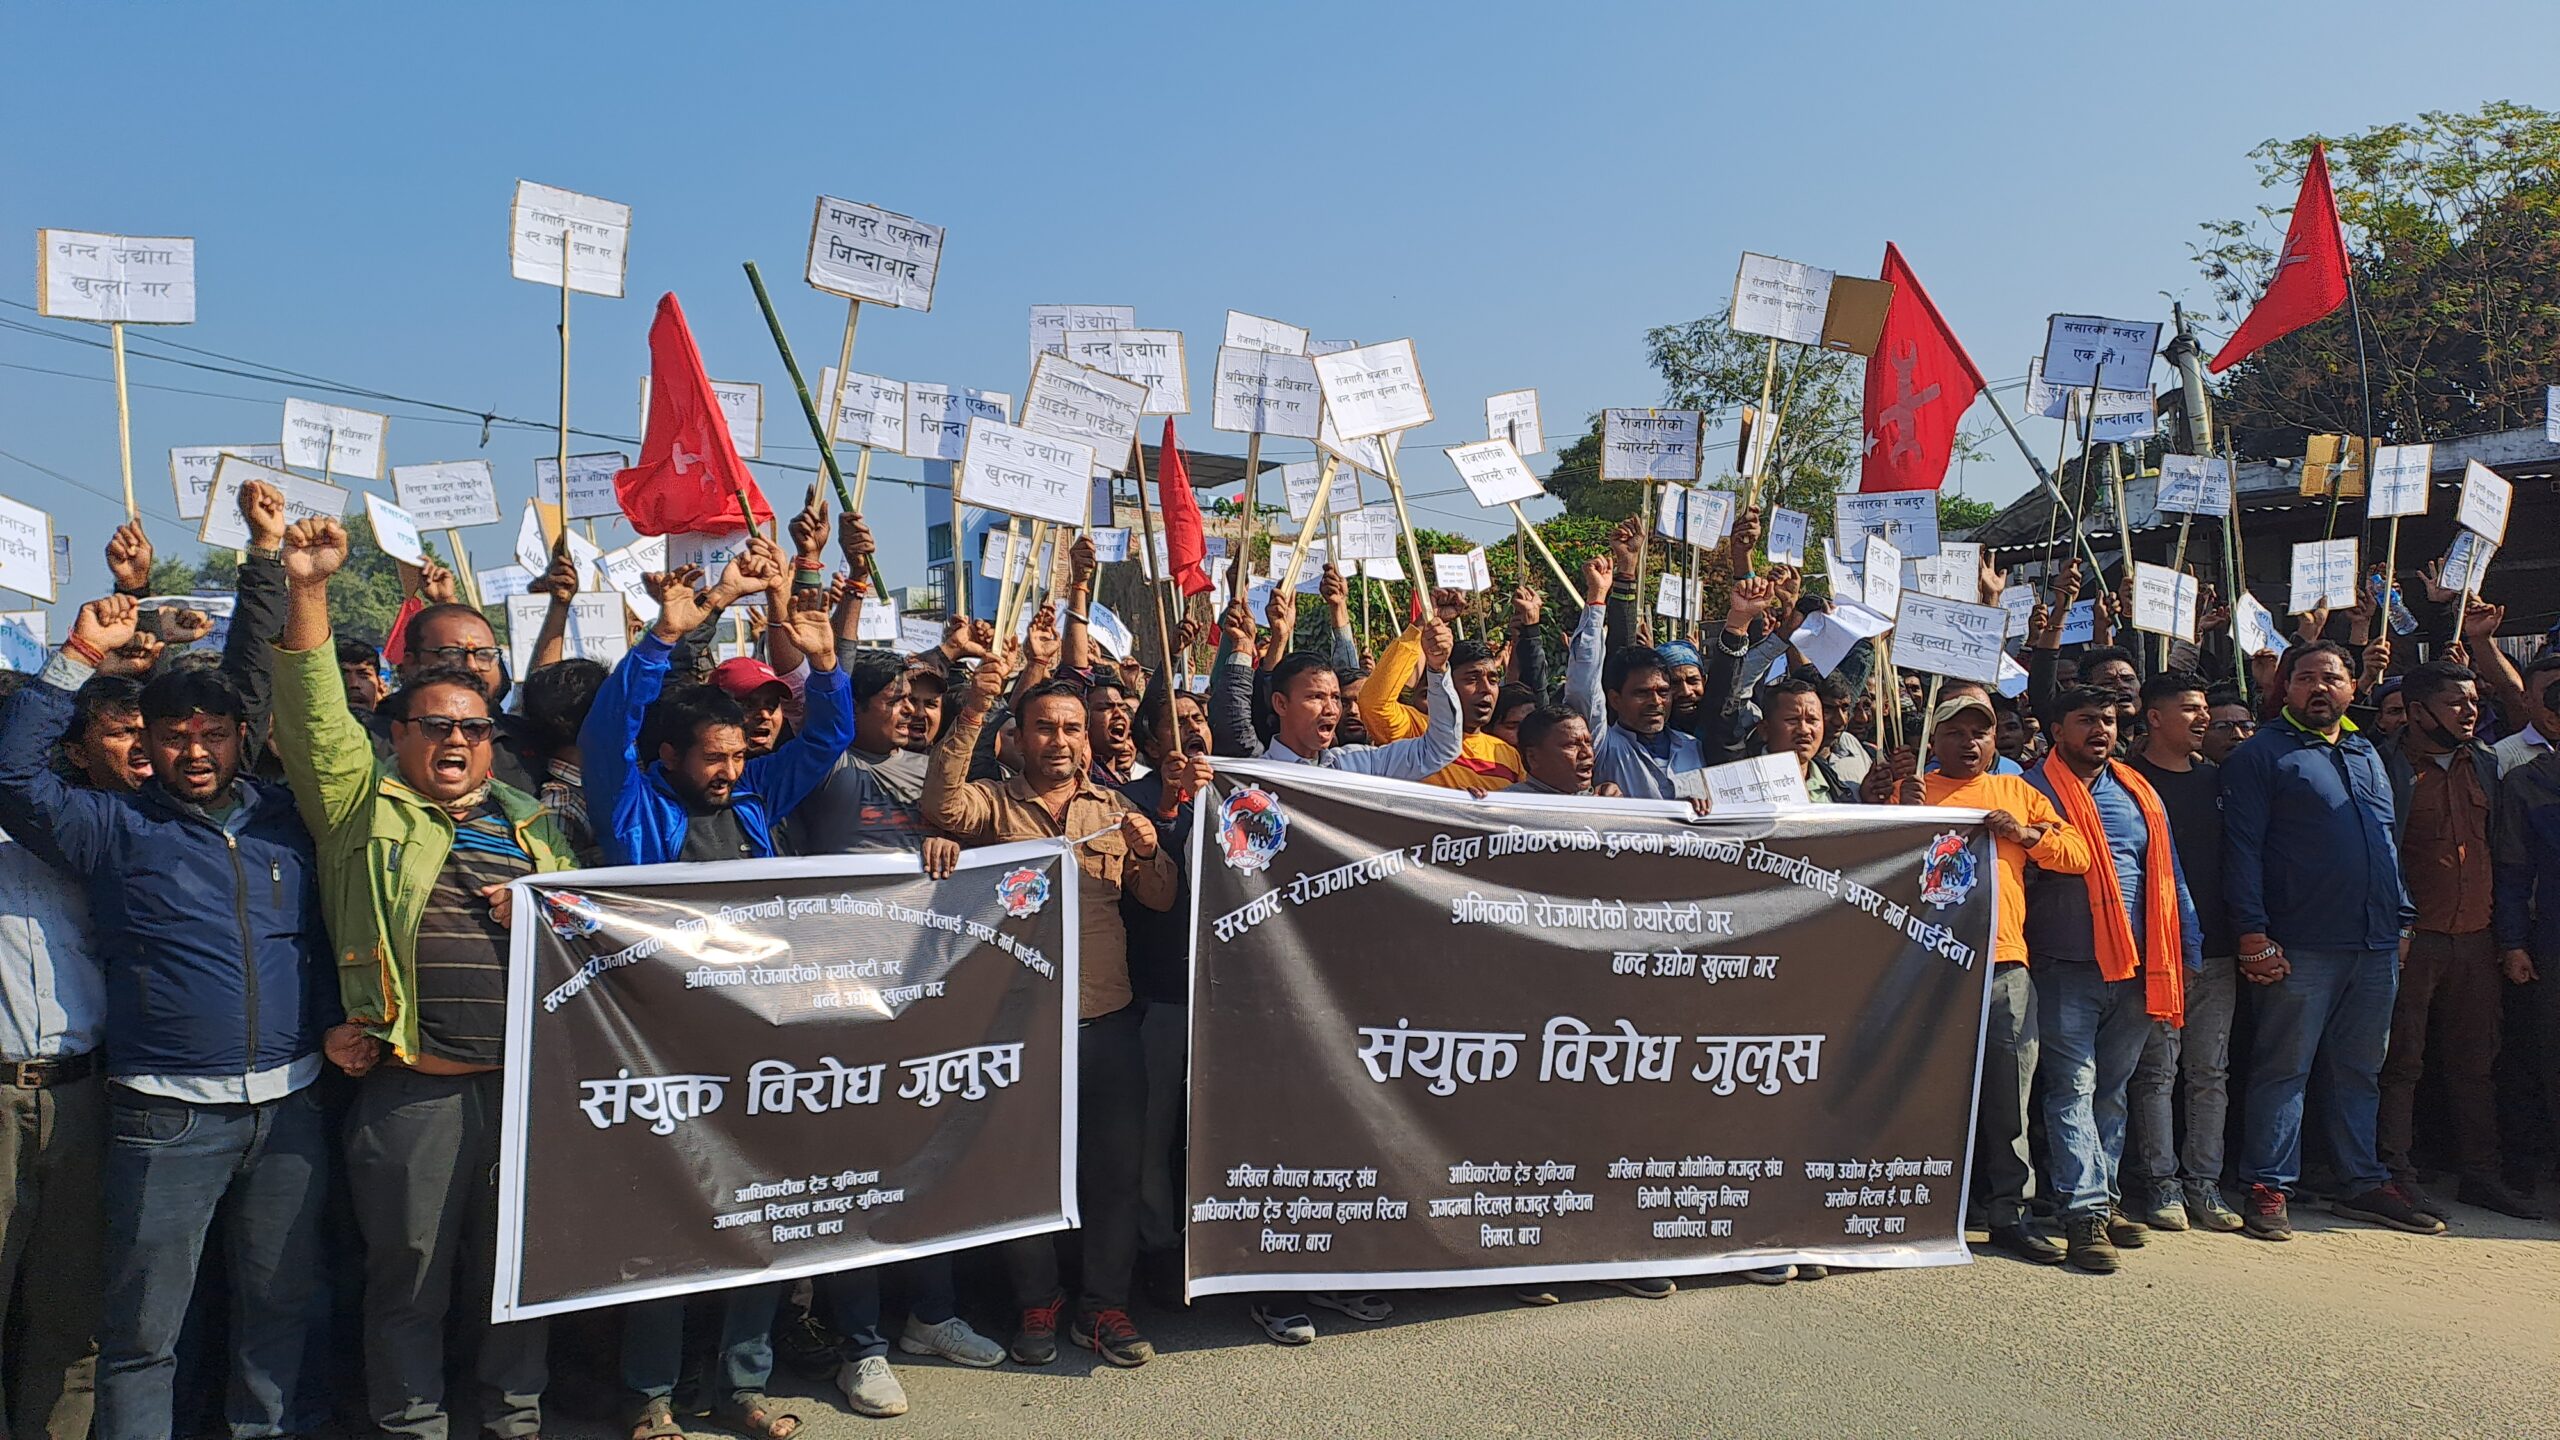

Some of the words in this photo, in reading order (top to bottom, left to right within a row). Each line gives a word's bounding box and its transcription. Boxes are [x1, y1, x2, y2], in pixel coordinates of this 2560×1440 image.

[597, 227, 610, 239] गर
[830, 208, 879, 237] मजदुर
[887, 224, 931, 248] एकता
[58, 243, 99, 260] बन्द
[112, 246, 172, 265] उद्योग
[599, 247, 611, 259] गर
[829, 236, 919, 281] जिन्दाबाद
[71, 276, 128, 298] खुल्ला
[142, 282, 172, 298] गर
[1752, 277, 1780, 289] रोजगारी
[1806, 287, 1817, 298] गर
[1762, 294, 1782, 307] उद्योग
[1806, 303, 1817, 315] गर
[1037, 315, 1067, 328] बन्द
[1074, 312, 1118, 329] उद्योग
[1236, 334, 1260, 347] रोजगारी
[2064, 322, 2107, 335] संसारका
[2113, 328, 2146, 342] मजदुर
[1081, 343, 1112, 357] बन्द
[1120, 338, 1167, 358] उद्योग
[2073, 349, 2095, 362] एक
[1143, 374, 1164, 389] गर
[1225, 370, 1267, 387] श्रमिकको
[1273, 377, 1313, 393] अधिकार
[1334, 372, 1363, 386] रोजगारी
[1392, 366, 1402, 376] गर
[916, 391, 958, 411] मजदुर
[966, 398, 1003, 413] एकता
[1233, 393, 1280, 410] सुनिश्चित
[1286, 401, 1301, 412] गर
[1353, 389, 1374, 401] उद्योग
[1400, 383, 1411, 391] गर
[2048, 386, 2063, 398] एक
[2118, 391, 2146, 401] एकता
[882, 417, 901, 431] गर
[1039, 394, 1080, 420] पाइदैन
[1084, 410, 1125, 435] पाइदैन
[1620, 416, 1684, 430] रोजगारीको
[291, 418, 333, 434] श्रमिकको
[338, 425, 373, 442] अधिकार
[348, 447, 362, 458] गर
[979, 430, 1013, 451] बन्द
[1024, 441, 1074, 467] उद्योग
[1460, 447, 1507, 464] रोजगारीको
[1617, 440, 1660, 454] ग्यारेन्टी
[1667, 443, 1686, 455] गर
[458, 478, 483, 491] पाइदैन
[985, 464, 1034, 487] खुल्ला
[1043, 479, 1068, 497] गर
[1471, 467, 1504, 484] ग्यारेन्टी
[1507, 466, 1520, 477] गर
[598, 488, 610, 498] गर
[1847, 498, 1888, 510] संसारका
[1894, 497, 1926, 510] मजदुर
[1374, 534, 1386, 543] गर
[607, 558, 636, 576] मजदुर
[1948, 551, 1972, 564] मजदुर
[1920, 574, 1936, 585] एक
[1907, 605, 1939, 618] बन्द
[1945, 605, 1989, 630] उद्योग
[584, 637, 606, 650] गर
[1911, 632, 1951, 652] खुल्ला
[1961, 640, 1984, 658] गर
[1719, 786, 1744, 800] विद्युत
[1773, 775, 1795, 788] पाइदैन
[1410, 844, 1426, 869] र
[1431, 833, 1484, 867] विद्युत
[1488, 825, 1600, 860] प्राधिकरणको
[1668, 830, 1745, 866] श्रमिकको
[1746, 841, 1841, 899] रोजगारीलाई
[1843, 878, 1885, 918] असर
[1883, 899, 1910, 932] गर्न
[830, 893, 884, 919] श्रमिकको
[887, 901, 962, 934] रोजगारीलाई
[965, 920, 996, 945] असर
[998, 931, 1013, 953] गर्न
[1451, 891, 1529, 926] श्रमिकको
[1533, 896, 1628, 931] रोजगारीको
[1632, 899, 1701, 934] ग्यारेन्टी
[1706, 909, 1734, 936] गर
[685, 965, 747, 990] श्रमिकको
[750, 961, 821, 986] रोजगारीको
[825, 959, 878, 980] ग्यारेन्टी
[881, 960, 902, 977] गर
[1612, 951, 1649, 977] बन्द
[1652, 946, 1698, 977] उद्योग
[1700, 954, 1751, 985] खुल्ला
[1753, 955, 1780, 980] गर
[812, 991, 840, 1009] बन्द
[881, 983, 922, 1008] खुल्ला
[925, 981, 945, 998] गर
[1357, 1017, 1527, 1096] संयुक्त
[1538, 1015, 1682, 1086] विरोध
[1691, 1033, 1827, 1096] जुलुस
[578, 1067, 732, 1136] संयुक्त
[745, 1055, 887, 1116] विरोध
[897, 1041, 1025, 1108] जुलुस
[1226, 1163, 1270, 1189] अखिल
[1272, 1164, 1311, 1188] नेपाल
[1312, 1168, 1354, 1193] मजदुर
[1356, 1166, 1378, 1188] संघ
[1448, 1160, 1512, 1184] आधिकारीक
[1514, 1161, 1532, 1187] ट्रेड
[1534, 1160, 1576, 1186] युनियन
[1606, 1157, 1644, 1180] अखिल
[1645, 1157, 1676, 1179] नेपाल
[1677, 1155, 1726, 1178] औद्योगिक
[1728, 1160, 1762, 1181] मजदुर
[1765, 1157, 1784, 1179] संघ
[1805, 1161, 1836, 1181] समग्र
[1838, 1158, 1867, 1180] उद्योग
[1868, 1158, 1883, 1183] ट्रेड
[1885, 1157, 1922, 1181] युनियन
[1923, 1155, 1953, 1178] नेपाल
[733, 1173, 806, 1204] आधिकारीक
[809, 1172, 829, 1196] ट्रेड
[830, 1169, 880, 1192] युनियन
[1824, 1188, 1858, 1209] असोक
[1859, 1187, 1886, 1207] स्टिल
[1914, 1183, 1931, 1205] लि.
[1428, 1198, 1472, 1219] जगदम्बा
[1515, 1196, 1551, 1218] मजदुर
[1552, 1189, 1594, 1217] युनियन
[1637, 1186, 1672, 1210] त्रिवेणी
[1720, 1186, 1750, 1208] मिल्स
[712, 1207, 762, 1231] जगदम्बा
[812, 1196, 853, 1219] मजदुर
[856, 1187, 905, 1211] युनियन
[1191, 1197, 1261, 1223] आधिकारीक
[1262, 1197, 1283, 1224] ट्रेड
[1286, 1197, 1333, 1225] युनियन
[1336, 1201, 1374, 1225] हुलास
[1376, 1197, 1408, 1222] स्टिल
[817, 1217, 843, 1237] बारा
[1710, 1218, 1733, 1238] बारा
[1884, 1215, 1906, 1234] बारा
[1305, 1232, 1332, 1252] बारा
[1518, 1226, 1541, 1246] बारा
